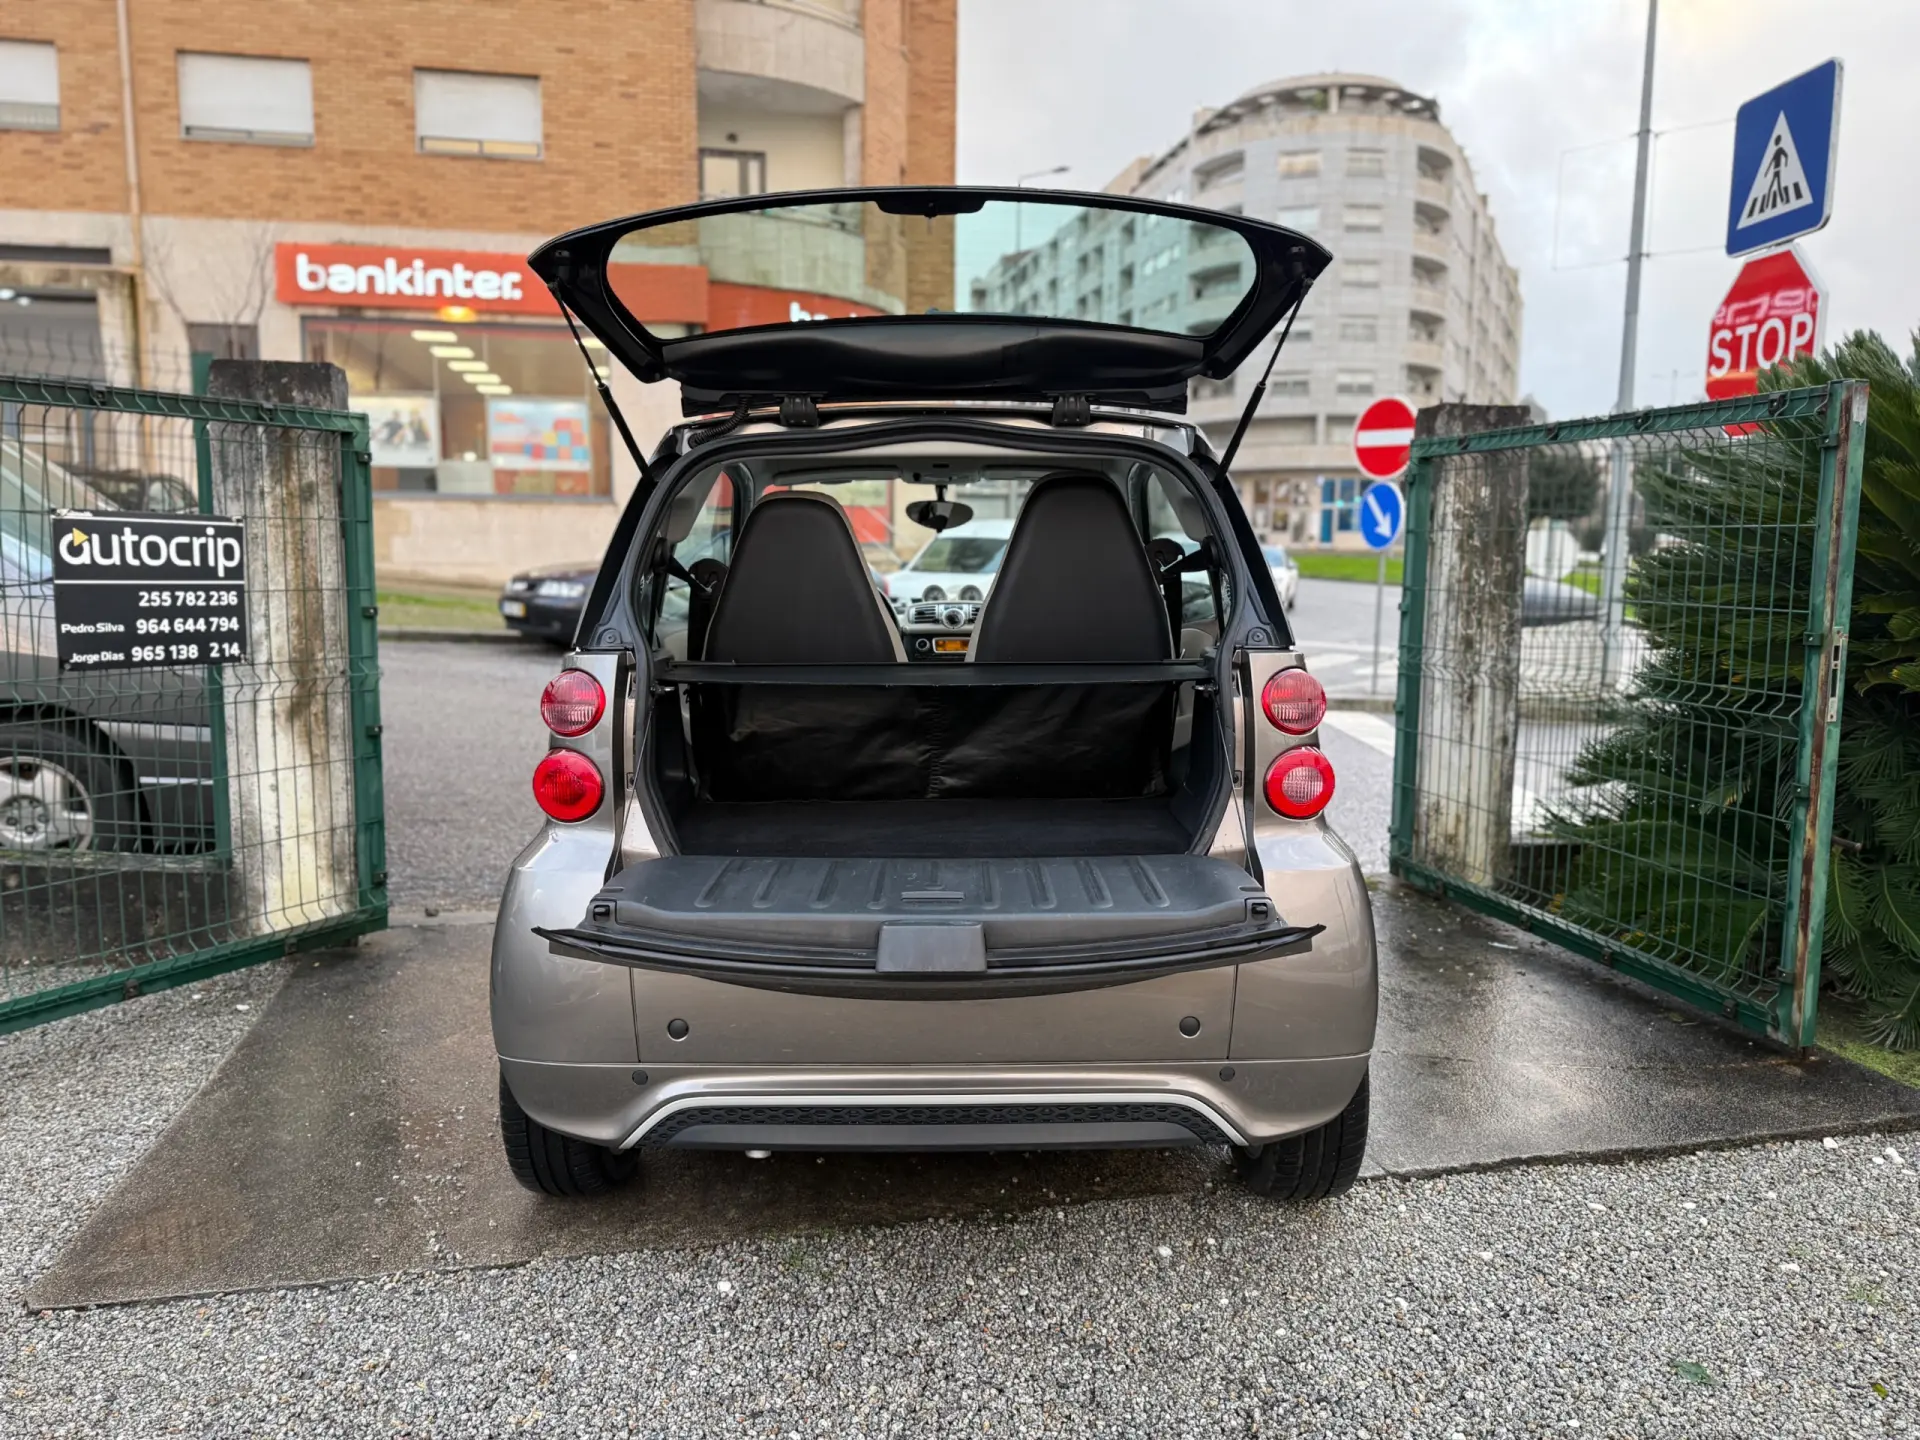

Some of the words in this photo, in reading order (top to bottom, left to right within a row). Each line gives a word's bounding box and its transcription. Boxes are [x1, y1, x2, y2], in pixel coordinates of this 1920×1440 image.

[1709, 312, 1813, 378] STOP
[59, 526, 241, 577] autocrip
[138, 591, 172, 607] 255
[174, 591, 206, 606] 782
[209, 590, 238, 606] 236
[61, 623, 95, 633] Pedro
[96, 622, 125, 633] Silva
[136, 618, 171, 634] 964
[173, 617, 206, 633] 644
[209, 617, 239, 632] 794
[69, 652, 100, 664] Jorge
[100, 651, 125, 662] Dias
[131, 645, 165, 662] 965
[169, 644, 198, 660] 138
